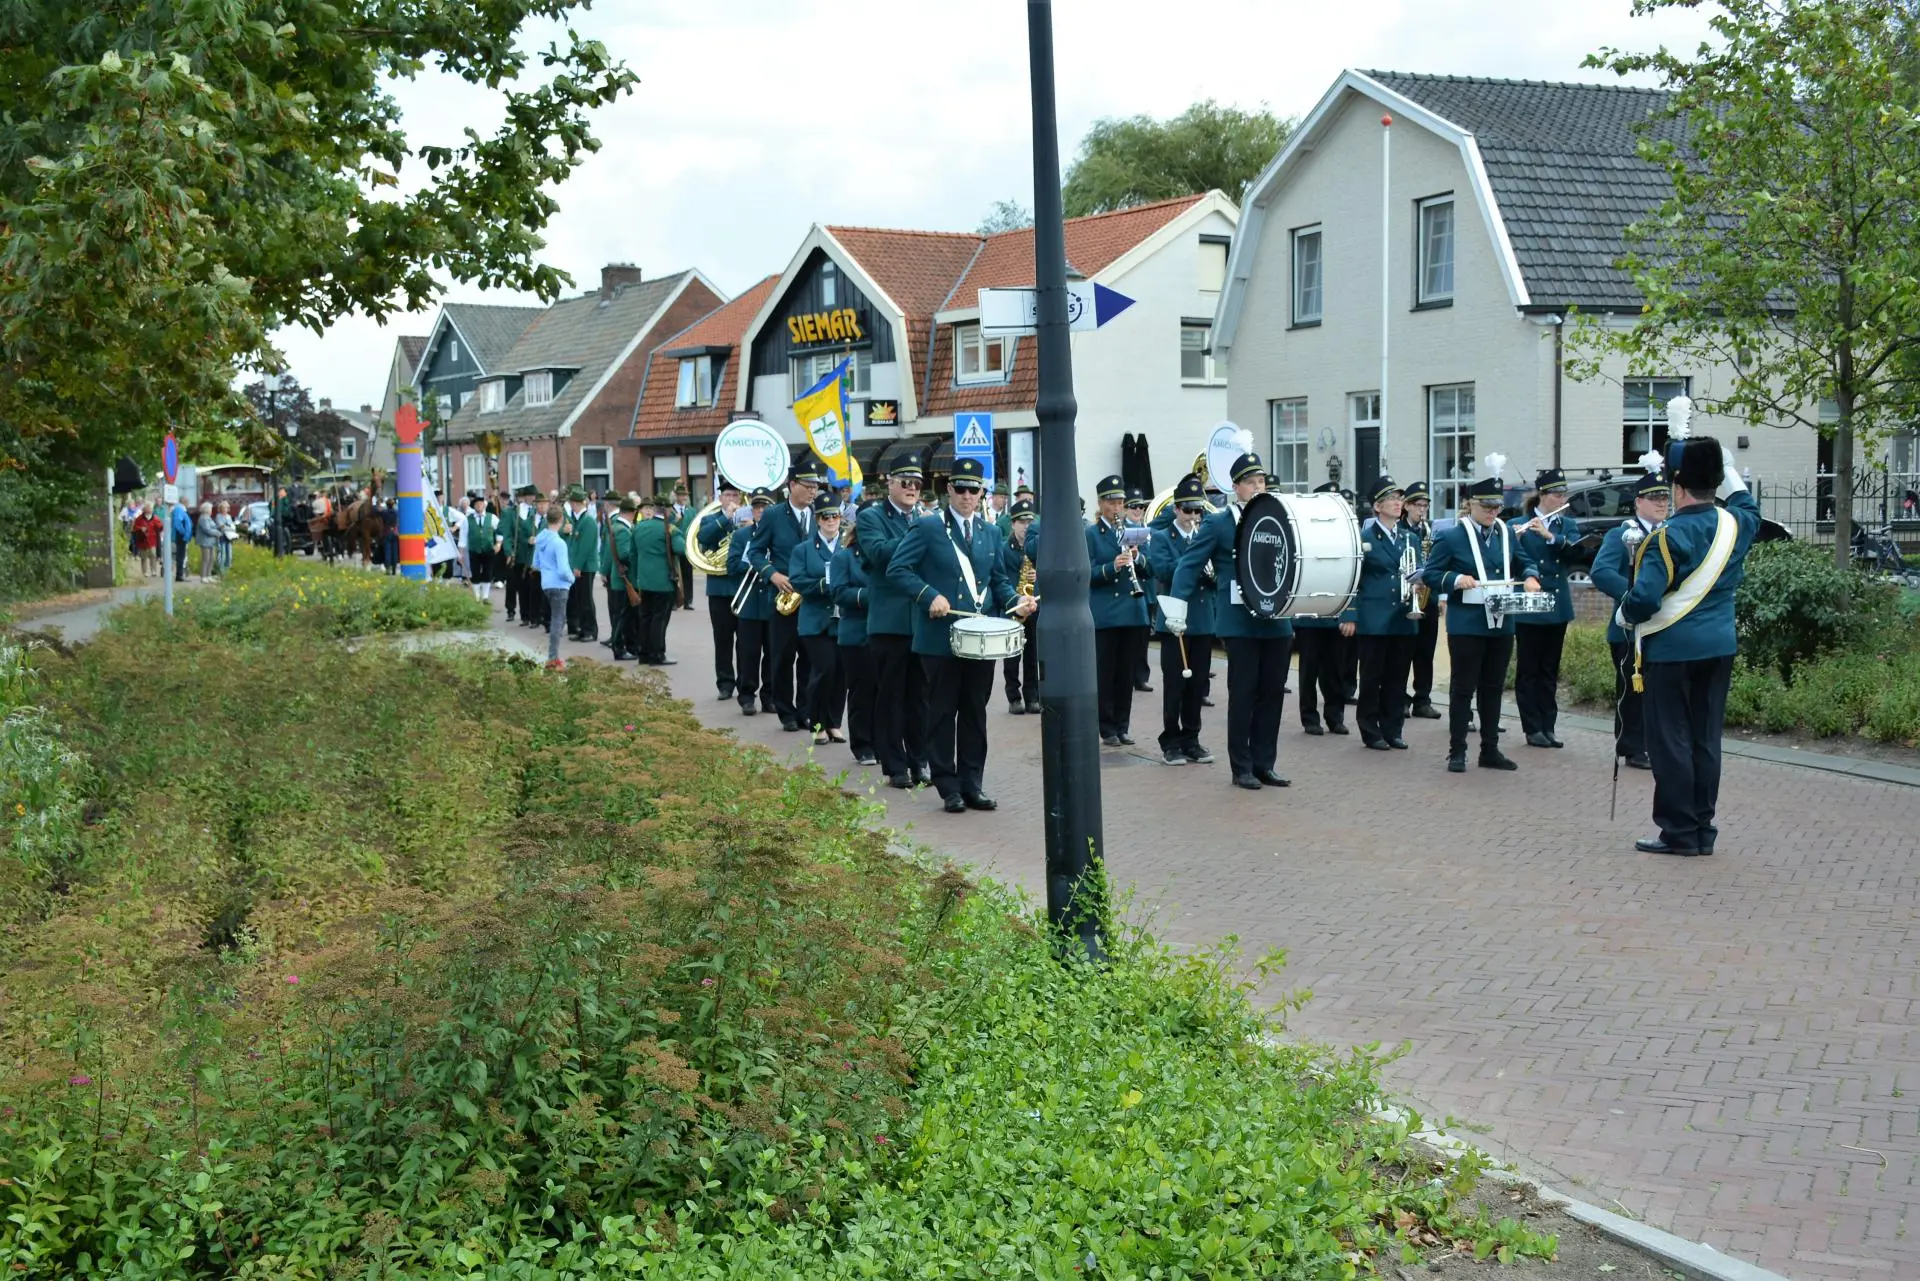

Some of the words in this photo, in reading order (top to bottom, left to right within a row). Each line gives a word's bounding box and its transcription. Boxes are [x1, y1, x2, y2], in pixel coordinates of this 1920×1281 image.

[787, 308, 862, 343] SIEMAR
[725, 439, 772, 448] AMICITIA
[1253, 534, 1282, 545] AMICITIA
